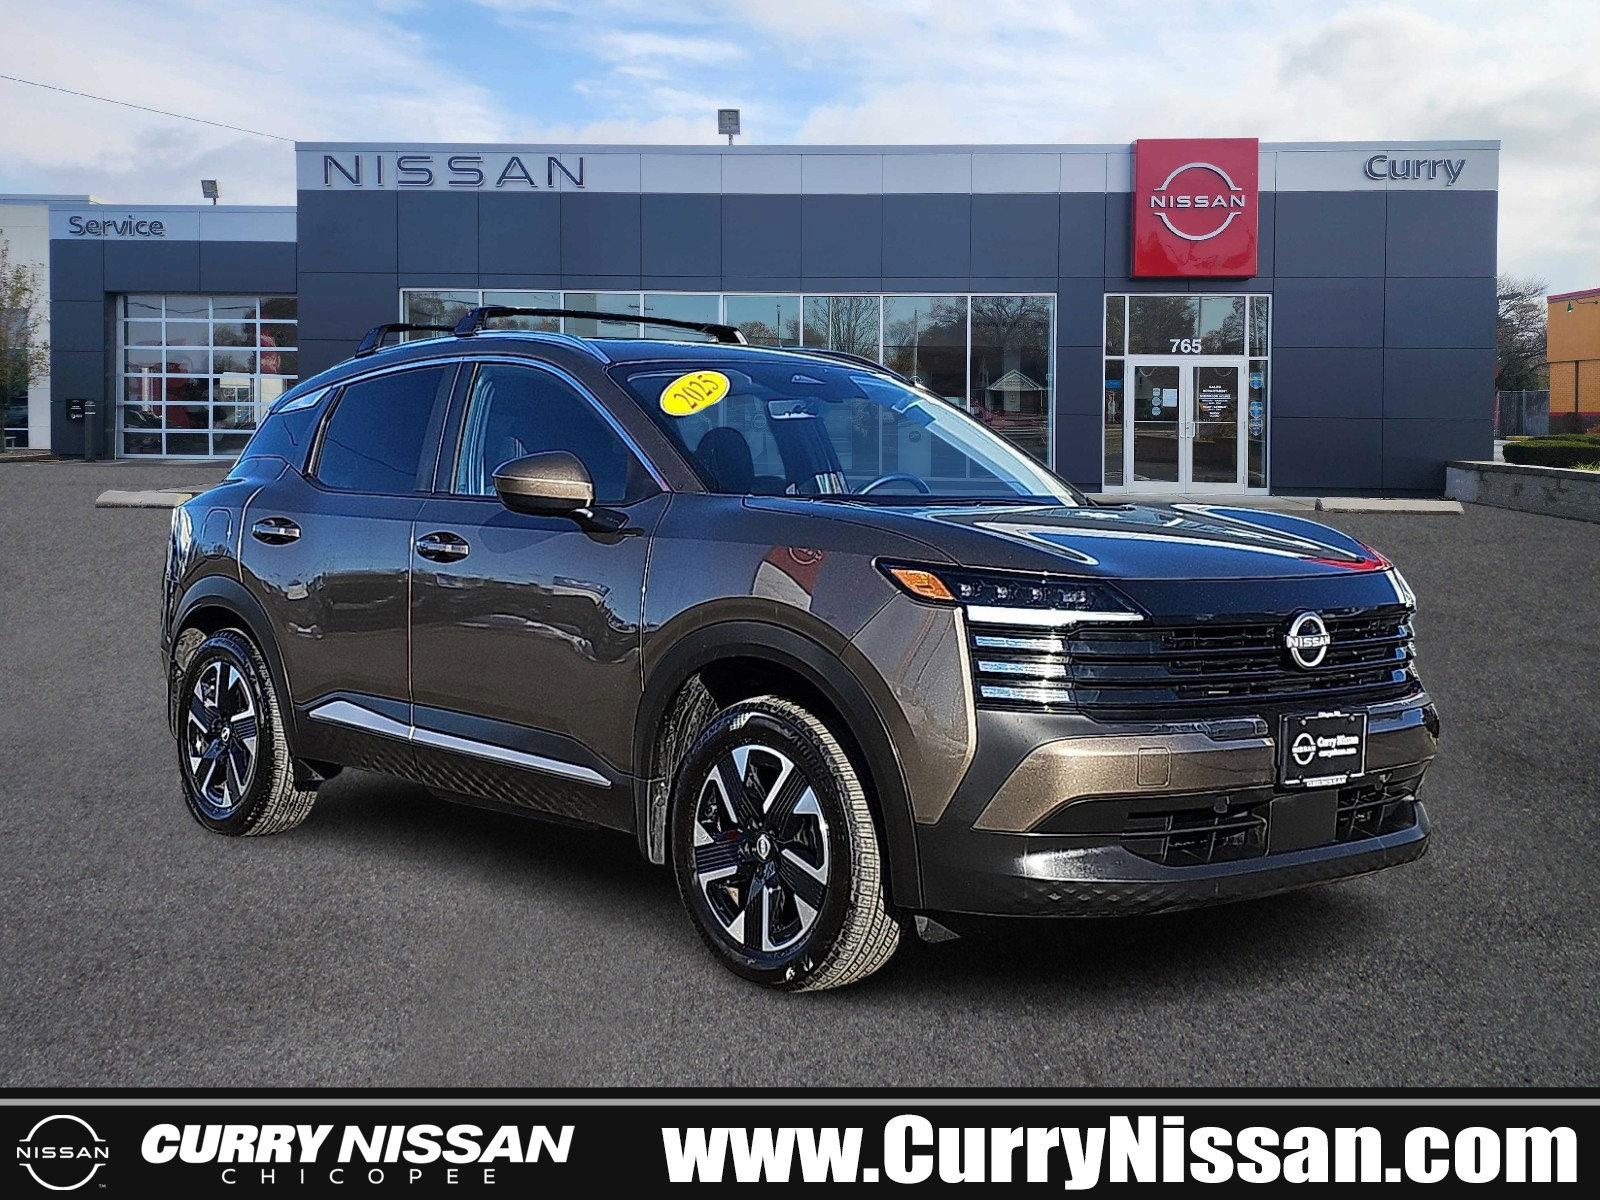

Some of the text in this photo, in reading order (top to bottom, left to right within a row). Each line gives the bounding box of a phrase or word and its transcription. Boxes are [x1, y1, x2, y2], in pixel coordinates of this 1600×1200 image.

[323, 155, 585, 189] NISSAN
[1364, 154, 1466, 187] Curry
[1150, 194, 1246, 209] NISSAN
[68, 214, 166, 237] Service
[1169, 338, 1203, 354] 765
[673, 374, 719, 410] 2025
[1286, 635, 1331, 648] NISSAN
[1317, 736, 1337, 748] Curry
